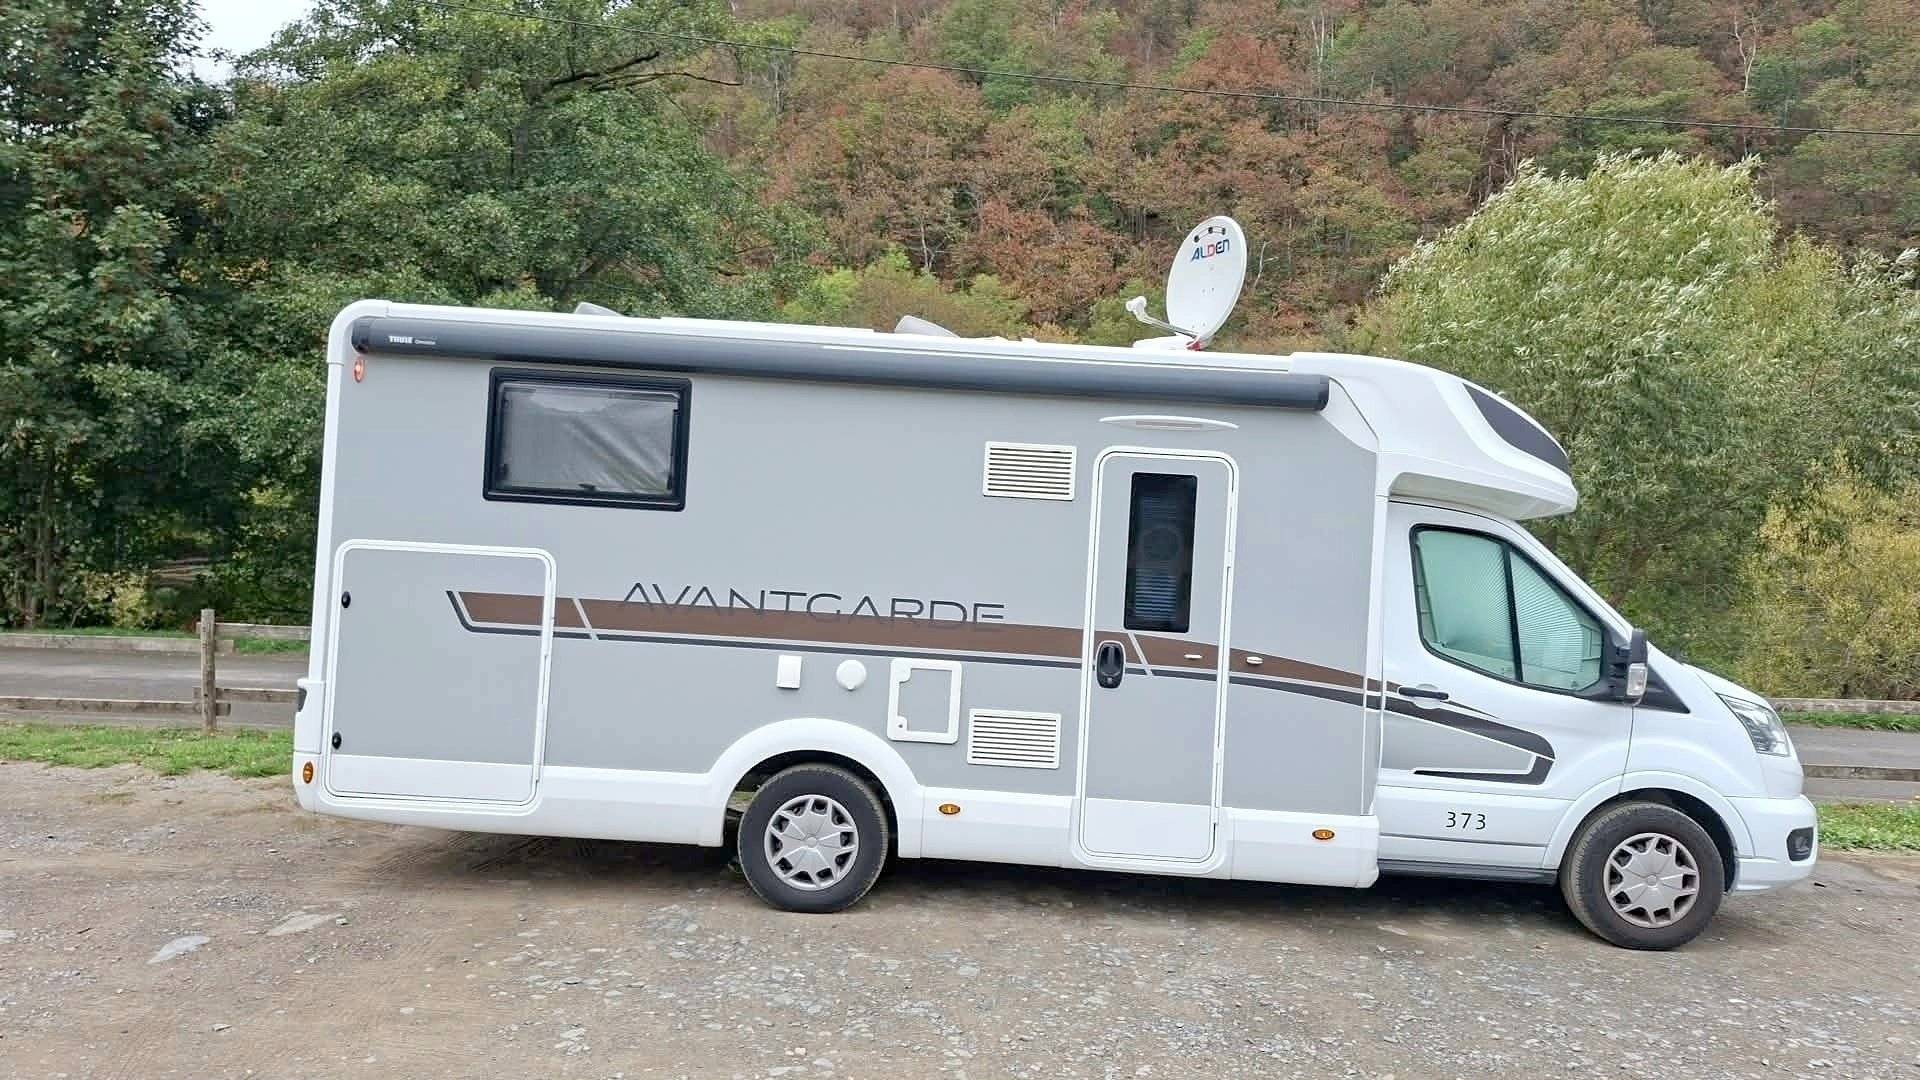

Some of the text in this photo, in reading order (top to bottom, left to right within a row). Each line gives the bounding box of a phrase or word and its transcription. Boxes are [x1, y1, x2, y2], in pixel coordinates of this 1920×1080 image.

[1190, 239, 1230, 262] ALDEN
[619, 582, 1005, 630] AVANTGARDE
[1445, 811, 1487, 831] 373
